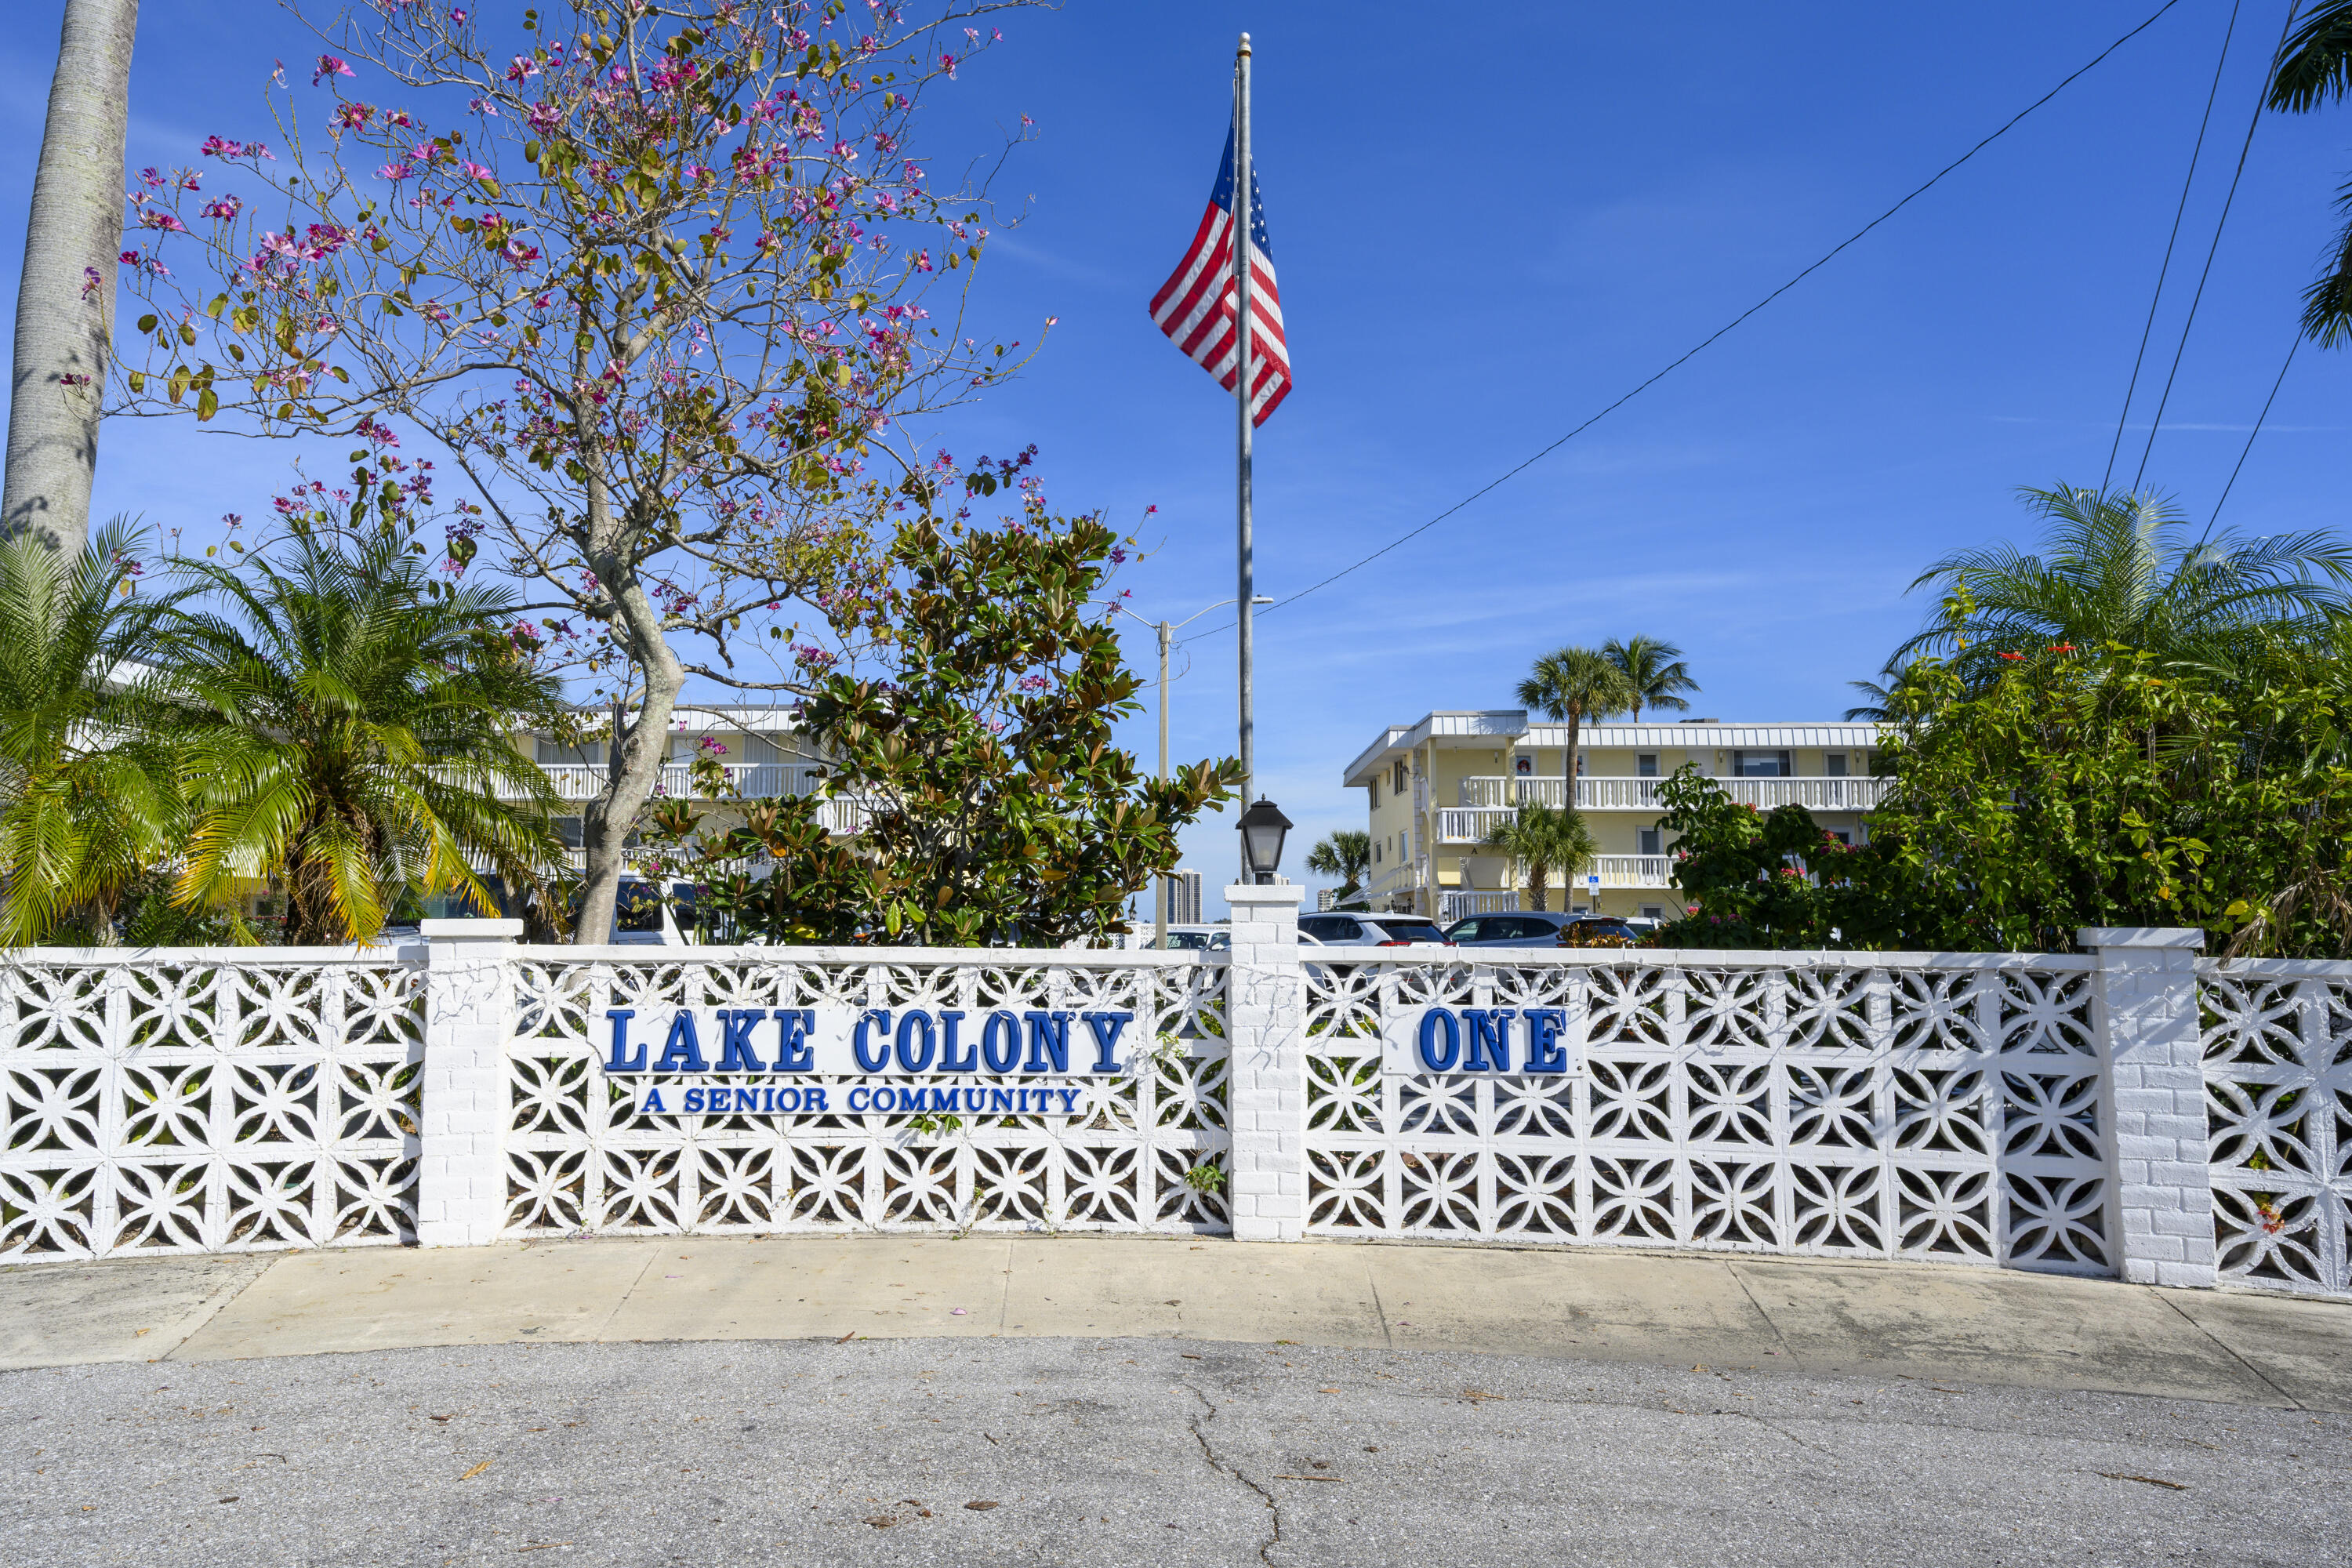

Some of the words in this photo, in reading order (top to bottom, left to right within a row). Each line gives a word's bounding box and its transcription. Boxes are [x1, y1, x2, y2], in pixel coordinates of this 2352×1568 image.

[604, 1009, 815, 1072] LAKE
[854, 1009, 1134, 1073] COLONY
[1419, 1007, 1567, 1073] ONE
[641, 1088, 666, 1112] A
[684, 1087, 829, 1112] SENIOR
[848, 1087, 1081, 1112] COMMUNITY
